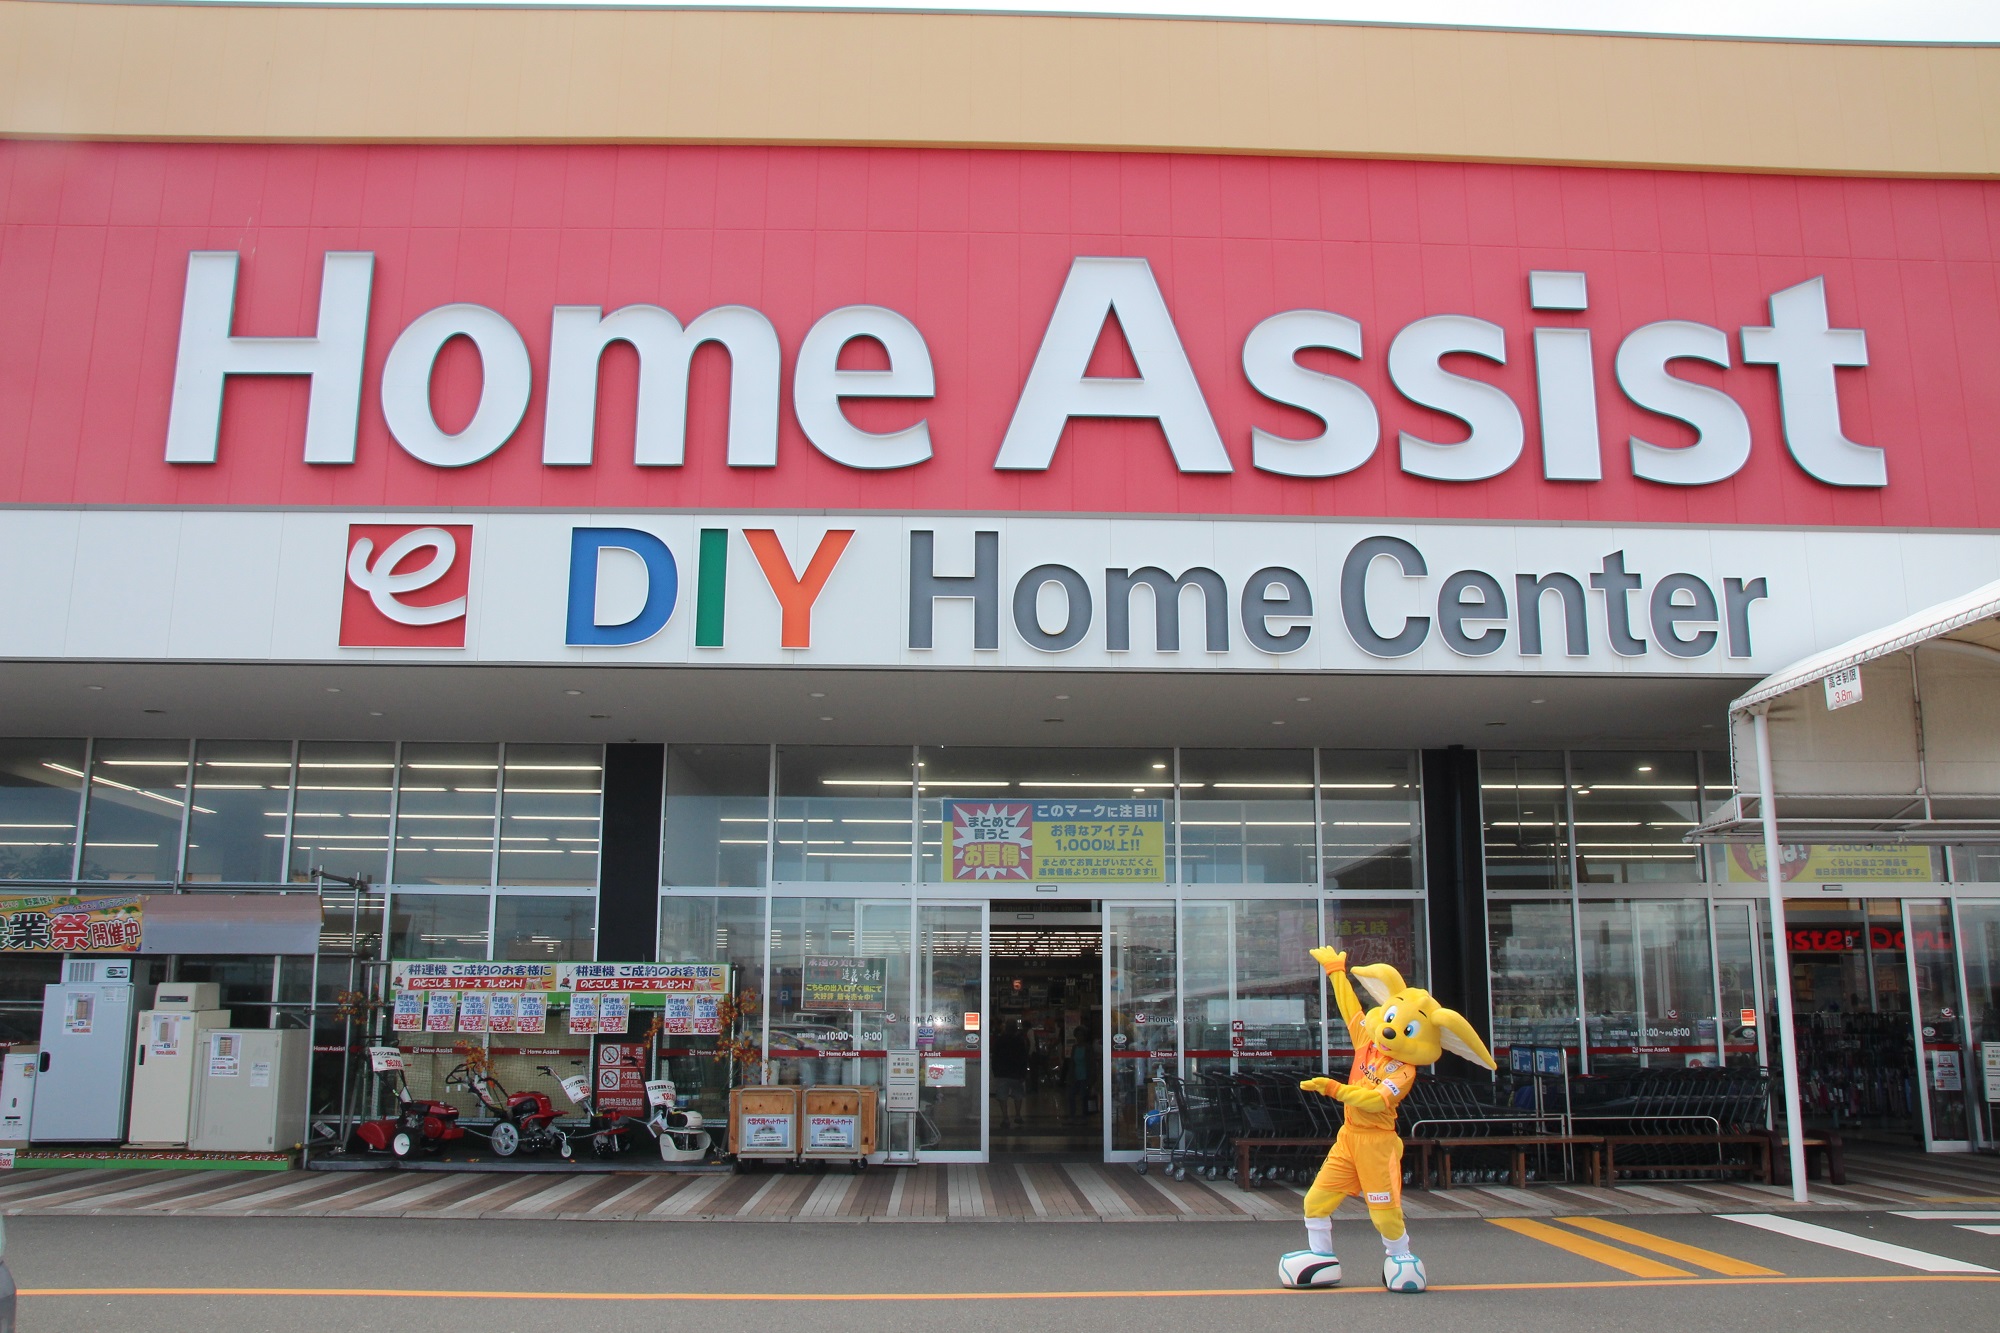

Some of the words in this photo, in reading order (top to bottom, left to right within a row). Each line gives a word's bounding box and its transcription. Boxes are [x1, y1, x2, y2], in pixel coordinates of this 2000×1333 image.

[164, 249, 936, 470] Home
[994, 257, 1889, 488] Assist
[565, 527, 856, 649] DIY
[908, 530, 1314, 654] Home
[1340, 535, 1769, 660] Center
[1835, 690, 1853, 703] 3.8m
[1037, 804, 1158, 818] このマークに注目!!
[968, 816, 1015, 828] まとめて
[974, 828, 1009, 840] 買うと
[1050, 824, 1144, 837] お得なアイテム
[964, 843, 1020, 867] お買得
